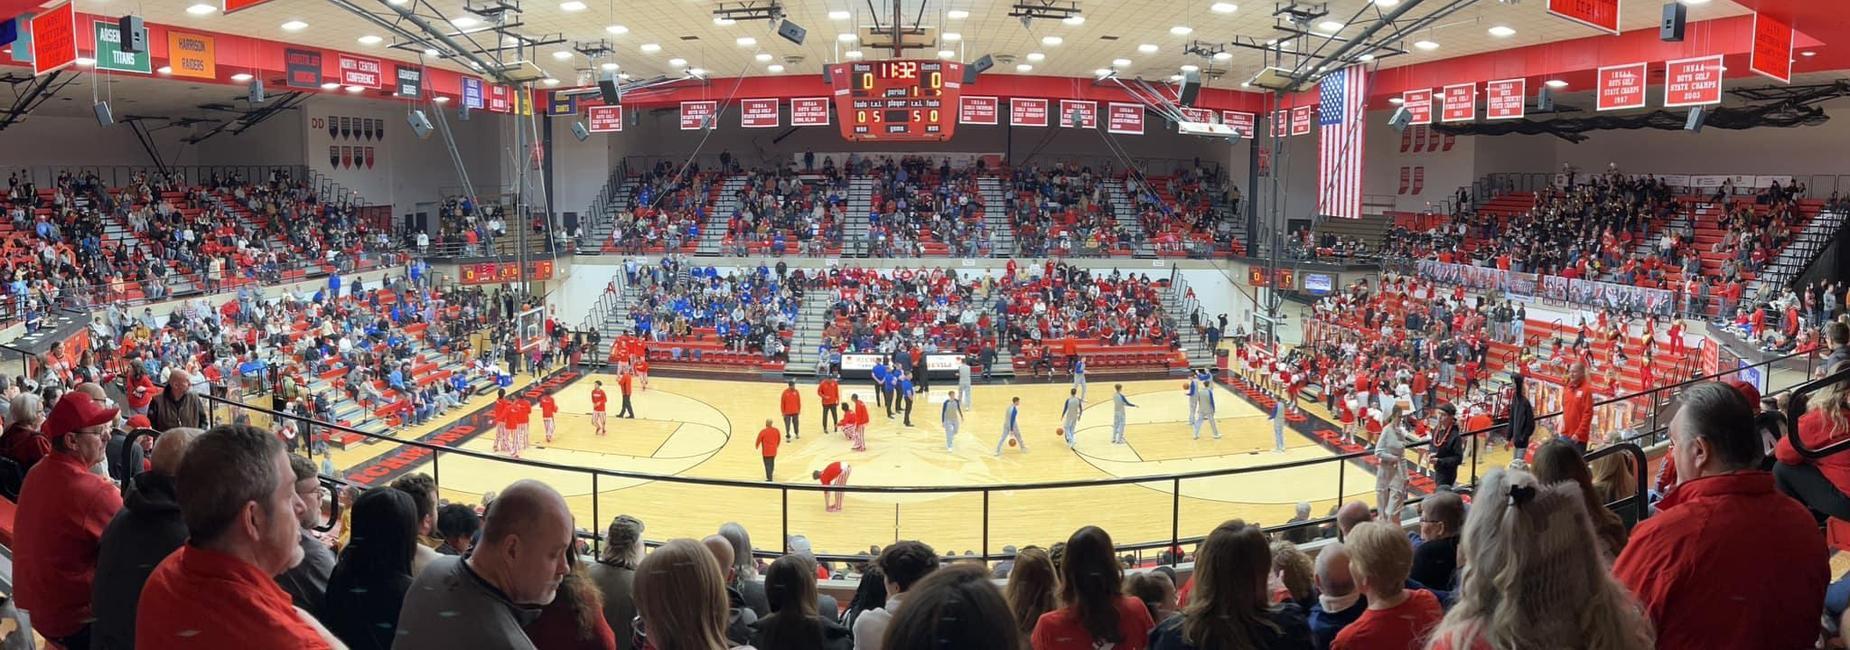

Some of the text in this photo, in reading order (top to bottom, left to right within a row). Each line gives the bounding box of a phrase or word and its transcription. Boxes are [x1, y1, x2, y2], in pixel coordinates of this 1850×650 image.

[100, 28, 121, 43] ARSEN
[178, 38, 206, 52] HARRISON
[112, 50, 136, 65] TITANS
[181, 57, 205, 71] RAIDERS
[358, 60, 379, 73] CENTRAL
[882, 62, 917, 78] 11:32
[346, 72, 375, 85] CONFERENCE
[863, 72, 873, 90] 0
[932, 72, 941, 88] 0
[1622, 77, 1634, 86] GOLF
[1677, 72, 1711, 82] BOYS GOLF
[888, 88, 906, 96] period
[913, 86, 918, 97] 1
[1670, 81, 1717, 92] STATE CHAMPS
[858, 111, 866, 123] 0
[873, 110, 881, 122] 5
[913, 110, 921, 122] 5
[930, 110, 938, 122] 0
